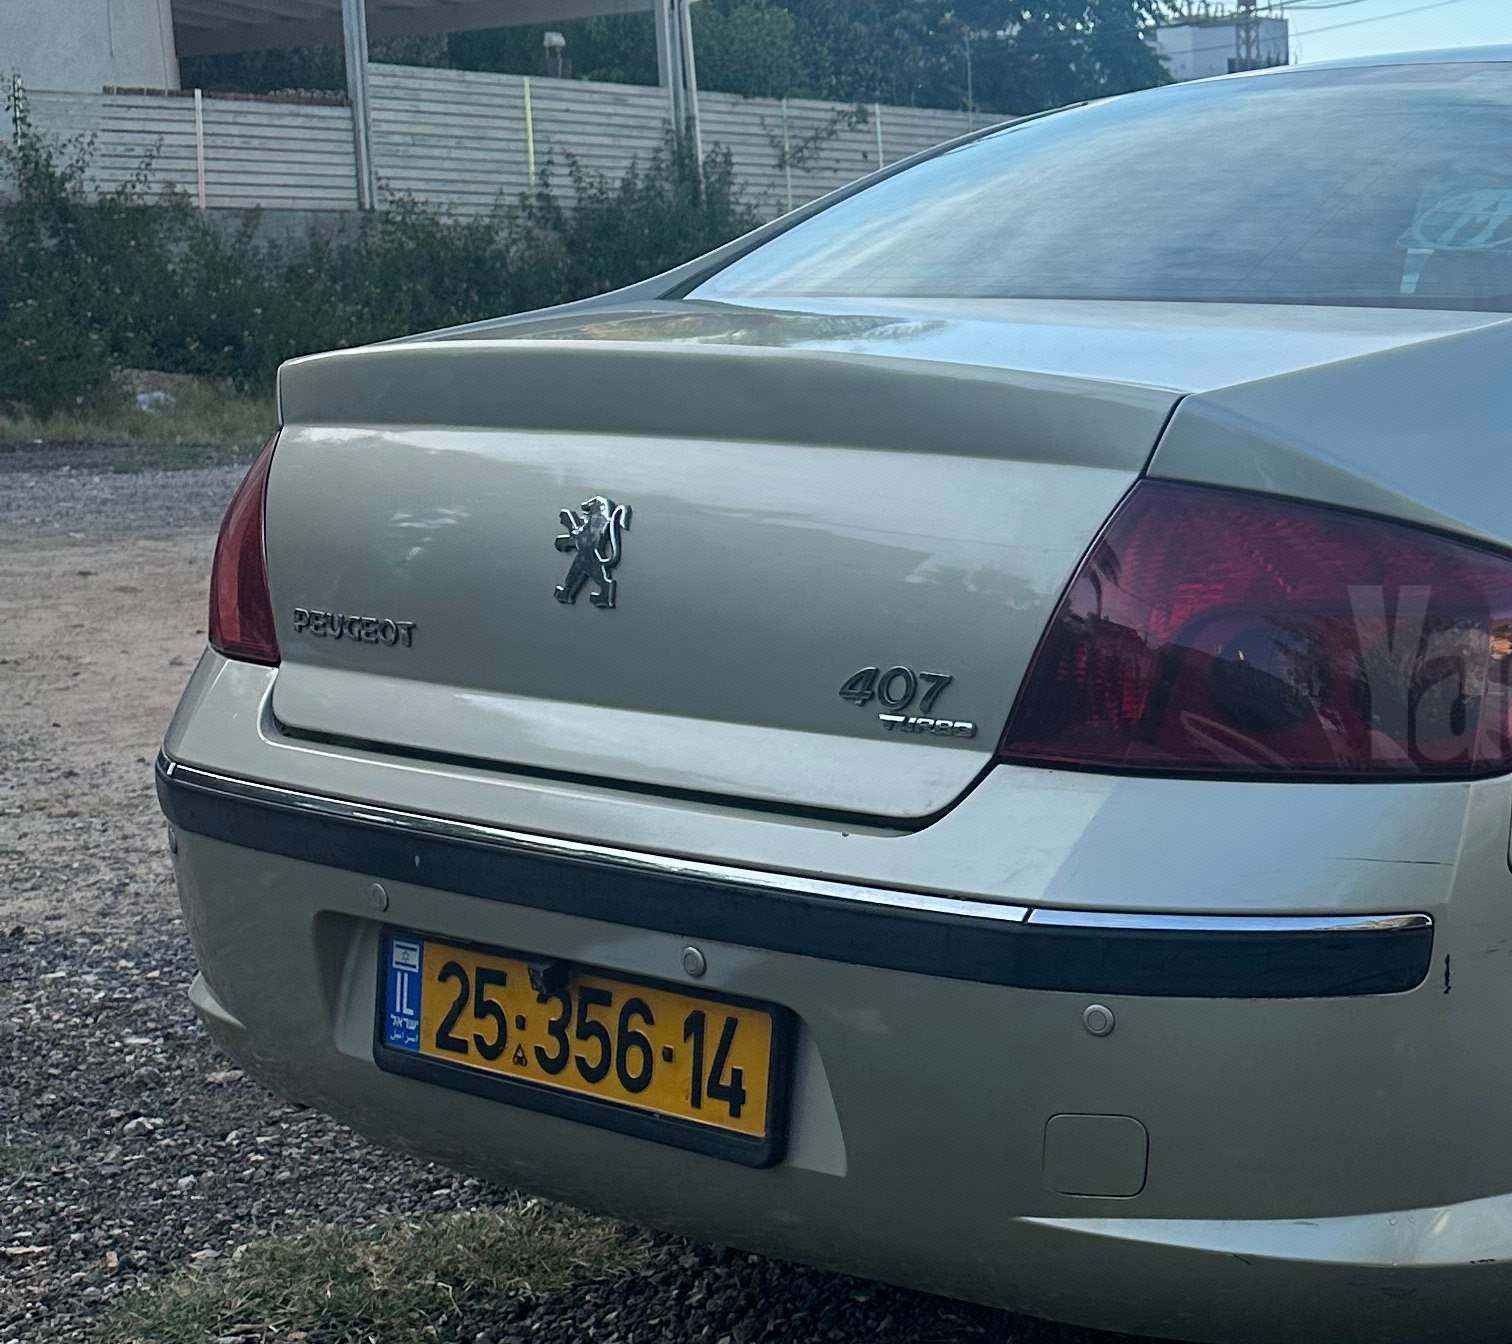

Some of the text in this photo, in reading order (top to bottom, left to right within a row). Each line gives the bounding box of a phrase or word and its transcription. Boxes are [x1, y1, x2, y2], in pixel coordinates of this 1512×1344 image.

[294, 608, 417, 647] PEUGEOT
[838, 665, 954, 714] 407
[877, 712, 978, 738] TURBO
[395, 970, 414, 1016] IL
